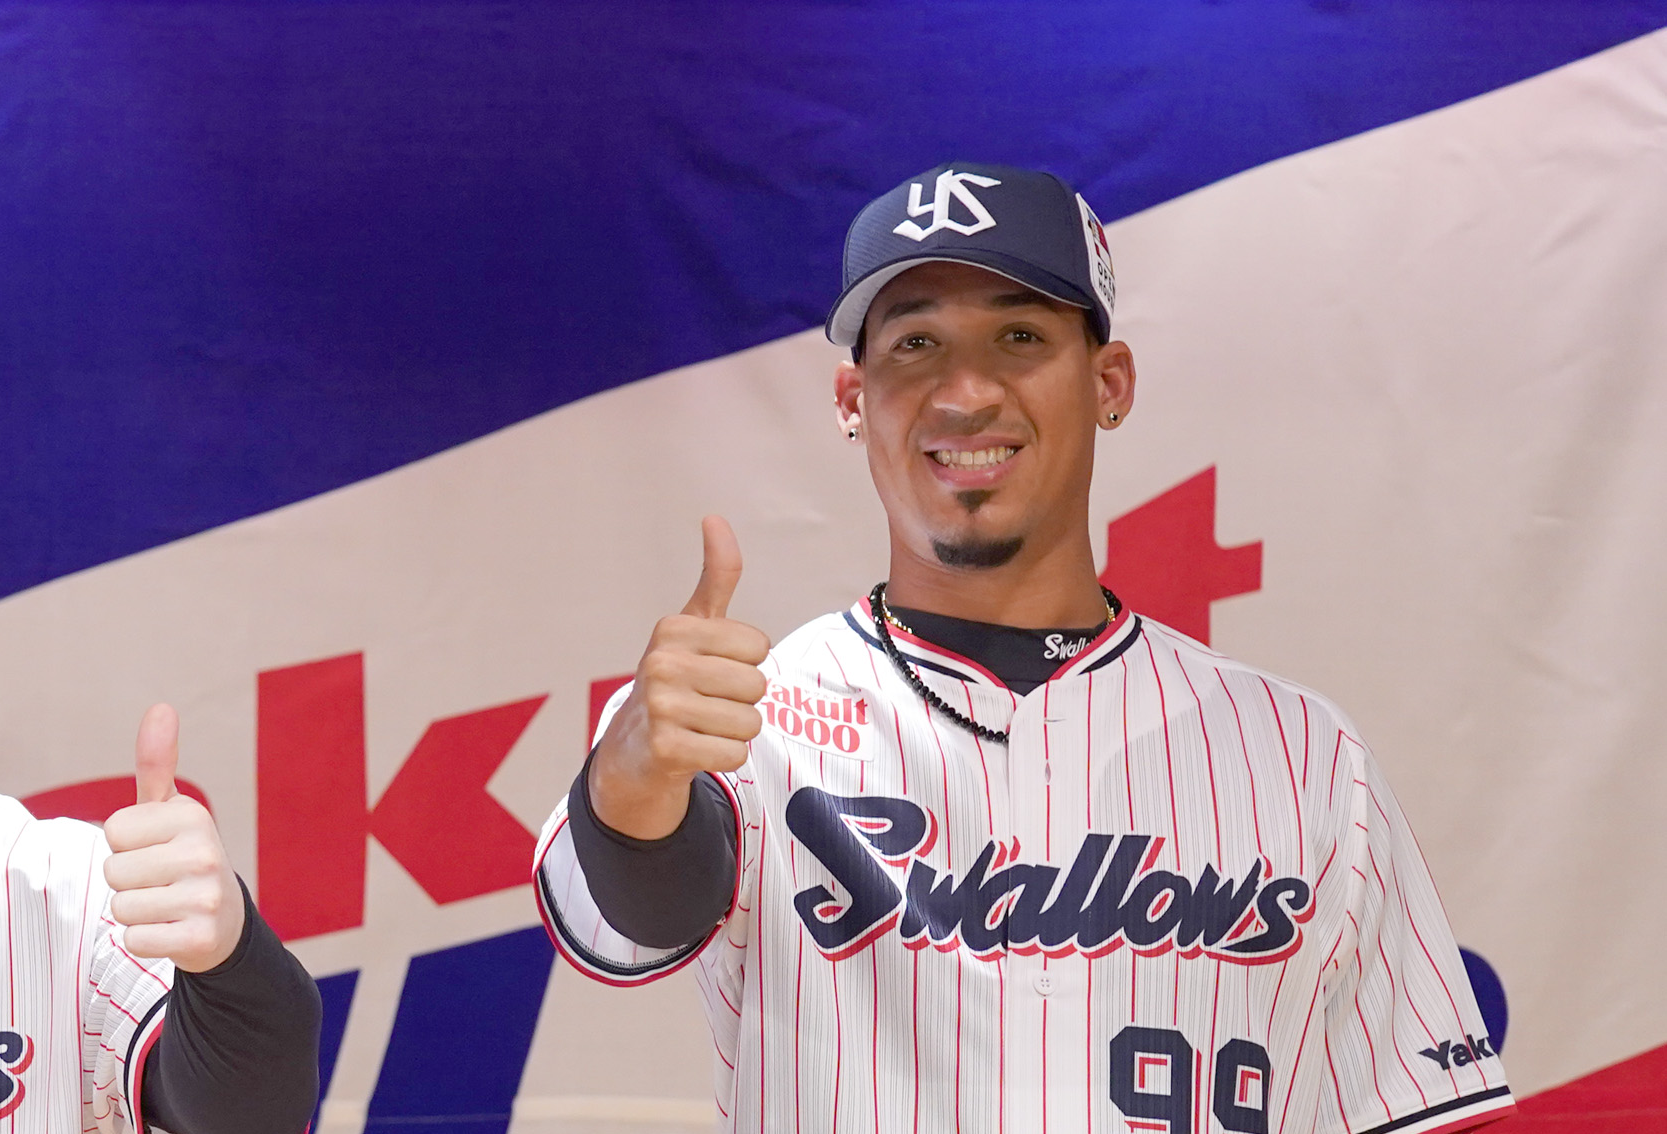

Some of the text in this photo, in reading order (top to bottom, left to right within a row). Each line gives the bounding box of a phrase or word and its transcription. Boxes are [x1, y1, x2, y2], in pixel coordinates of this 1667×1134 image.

[1043, 633, 1098, 660] Swall
[760, 701, 861, 753] 1000
[785, 785, 1317, 966] Swallows
[1417, 1033, 1495, 1071] Yak
